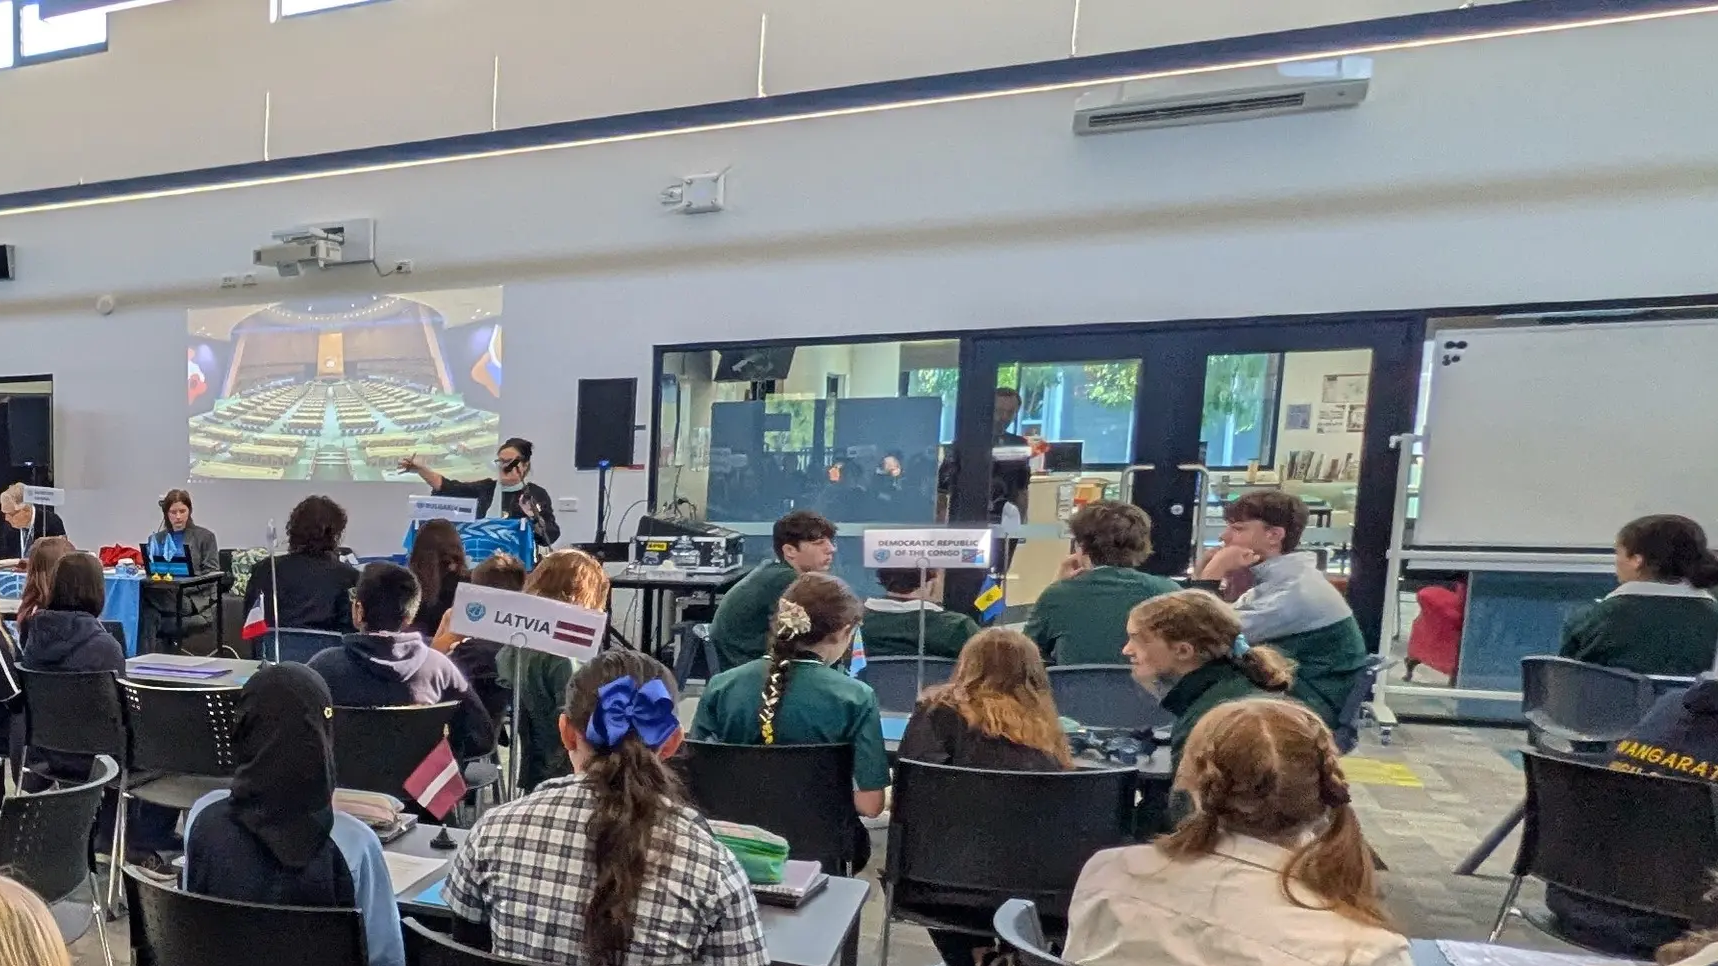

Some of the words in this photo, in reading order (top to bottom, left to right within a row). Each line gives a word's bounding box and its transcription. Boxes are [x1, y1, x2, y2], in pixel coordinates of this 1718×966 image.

[878, 539, 935, 547] DEMOCRATIC
[936, 539, 979, 547] REPUBLIC
[894, 549, 905, 557] OF
[908, 549, 926, 557] THE
[927, 549, 960, 557] CONGO
[493, 610, 551, 635] LATVIA
